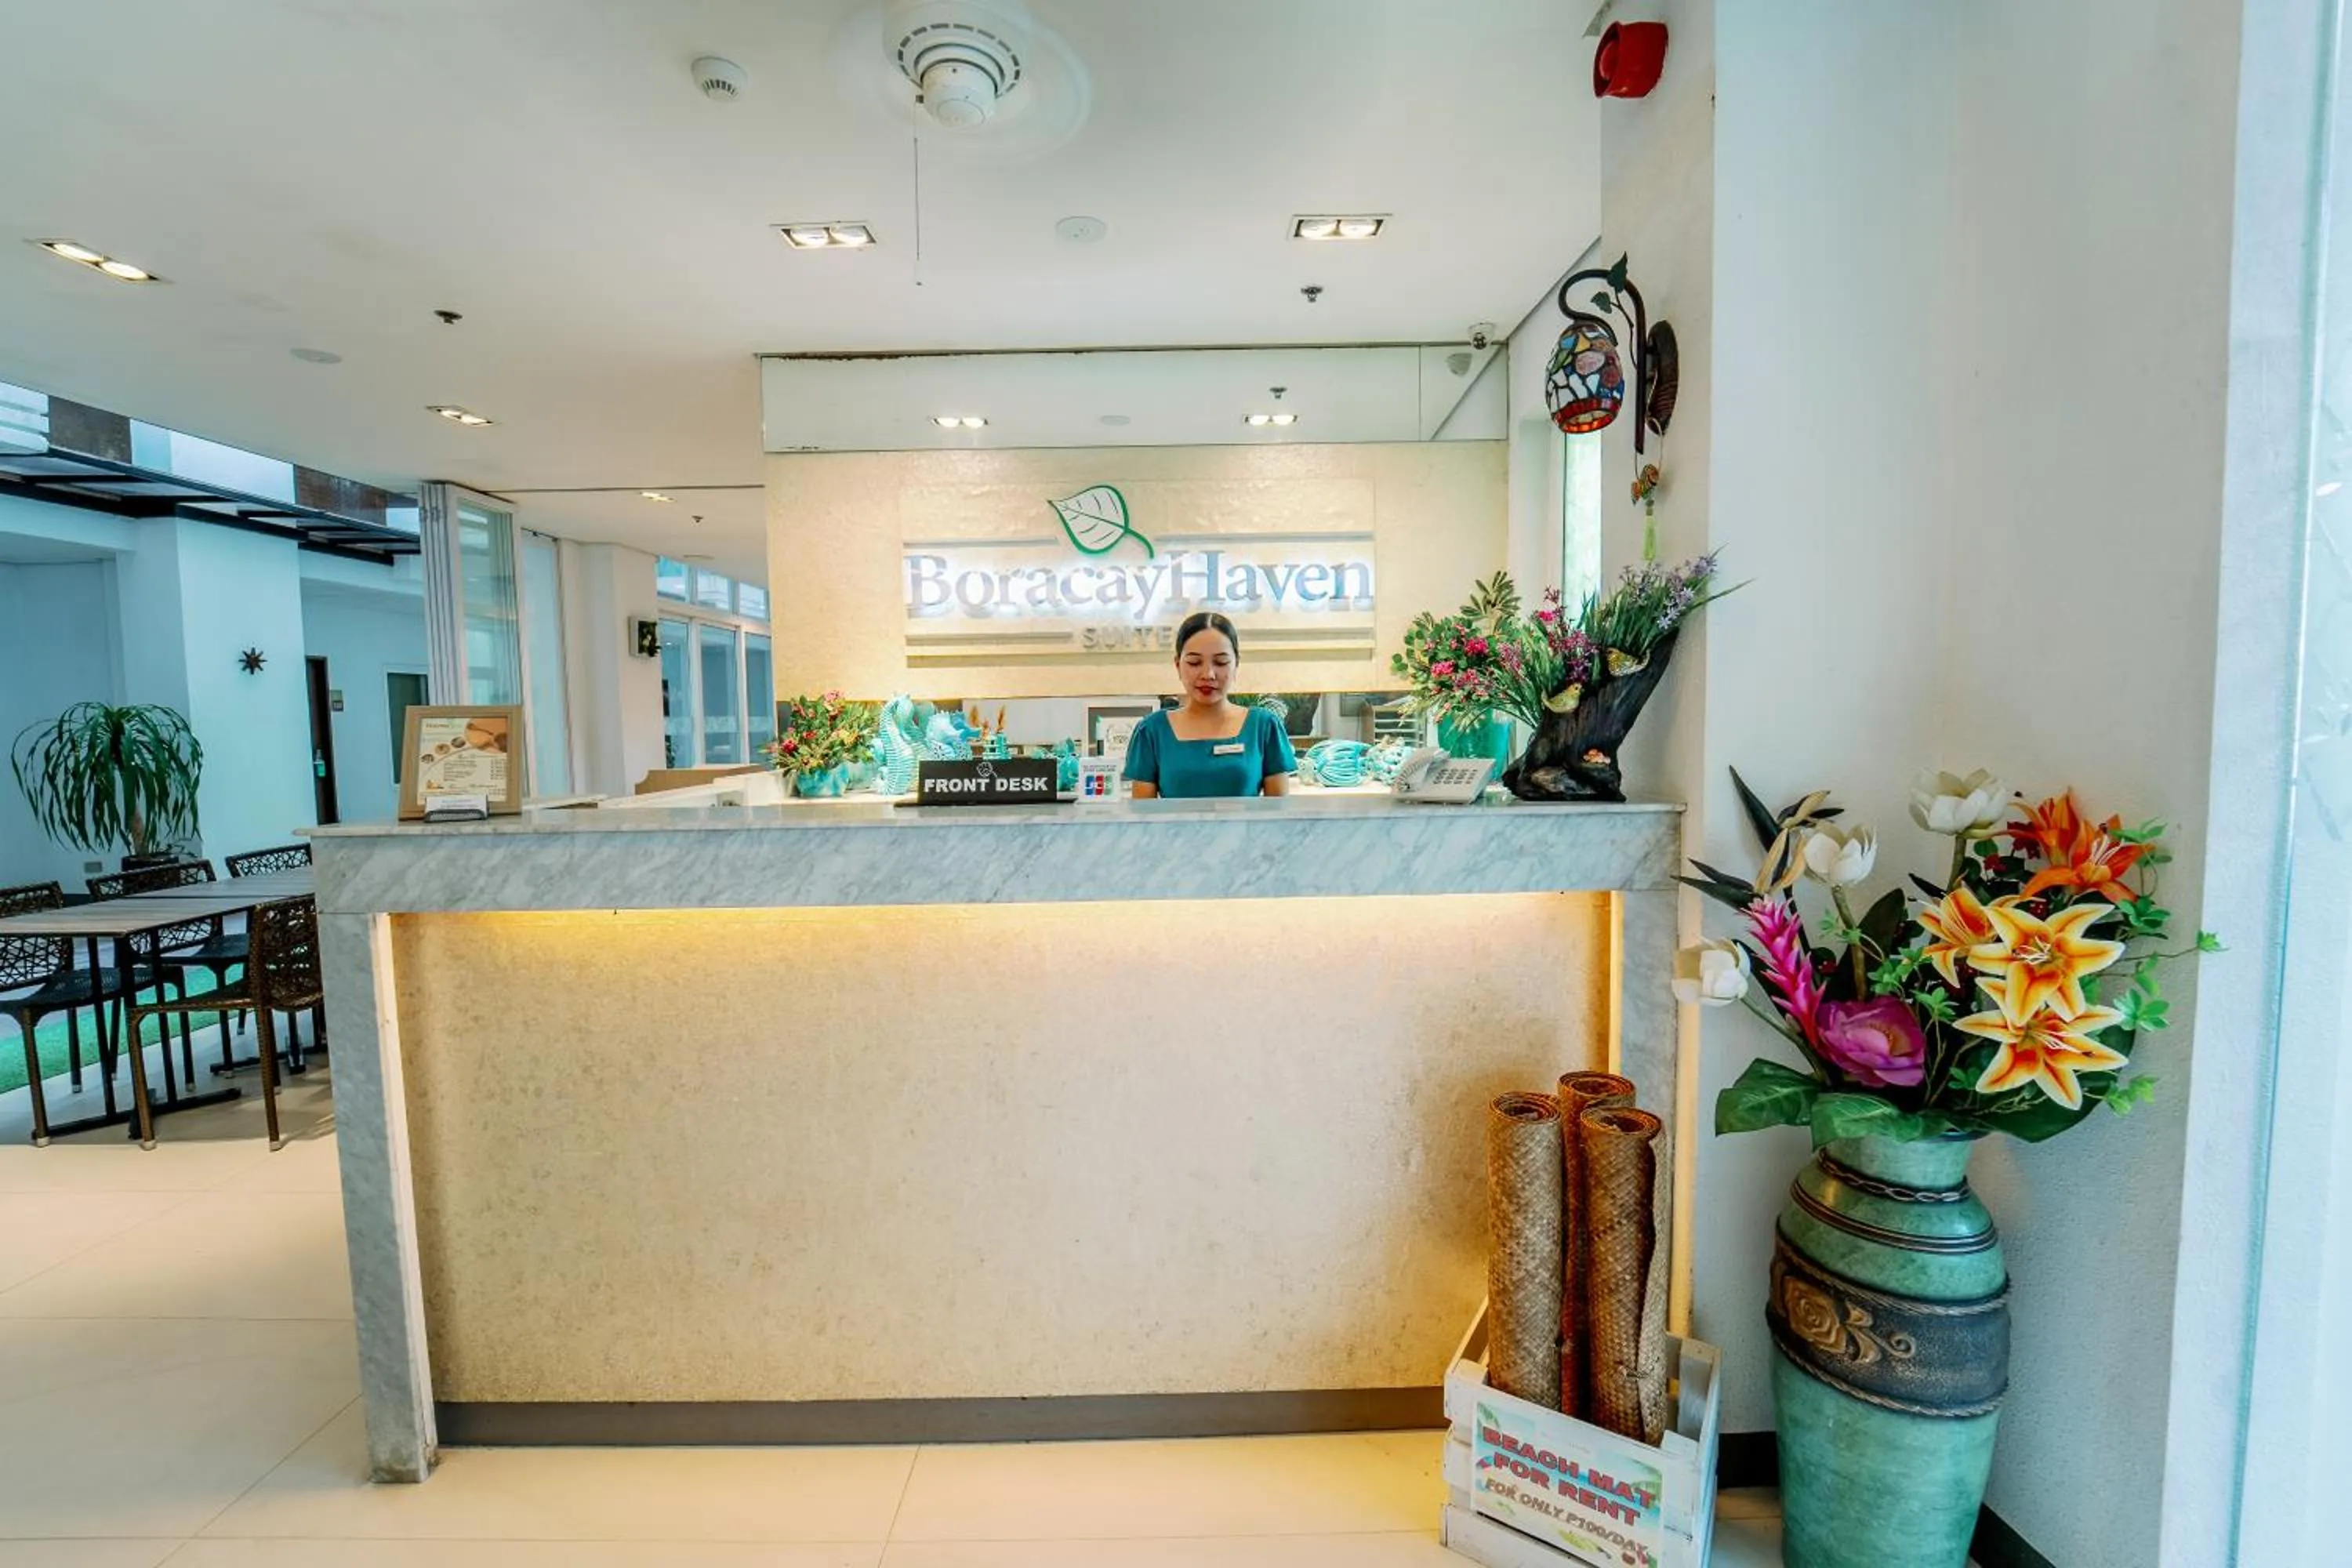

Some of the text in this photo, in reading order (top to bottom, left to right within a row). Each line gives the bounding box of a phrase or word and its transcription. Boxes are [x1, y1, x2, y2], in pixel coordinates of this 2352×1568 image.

[906, 550, 1374, 619] BoracayHaven
[1083, 626, 1173, 652] SUITE
[924, 776, 1048, 793] FRONT DESK
[1482, 1425, 1656, 1509] BEACH MAT
[1494, 1451, 1641, 1526] FOR RENT
[1485, 1478, 1517, 1501] FOR
[1521, 1493, 1566, 1518] ONLY
